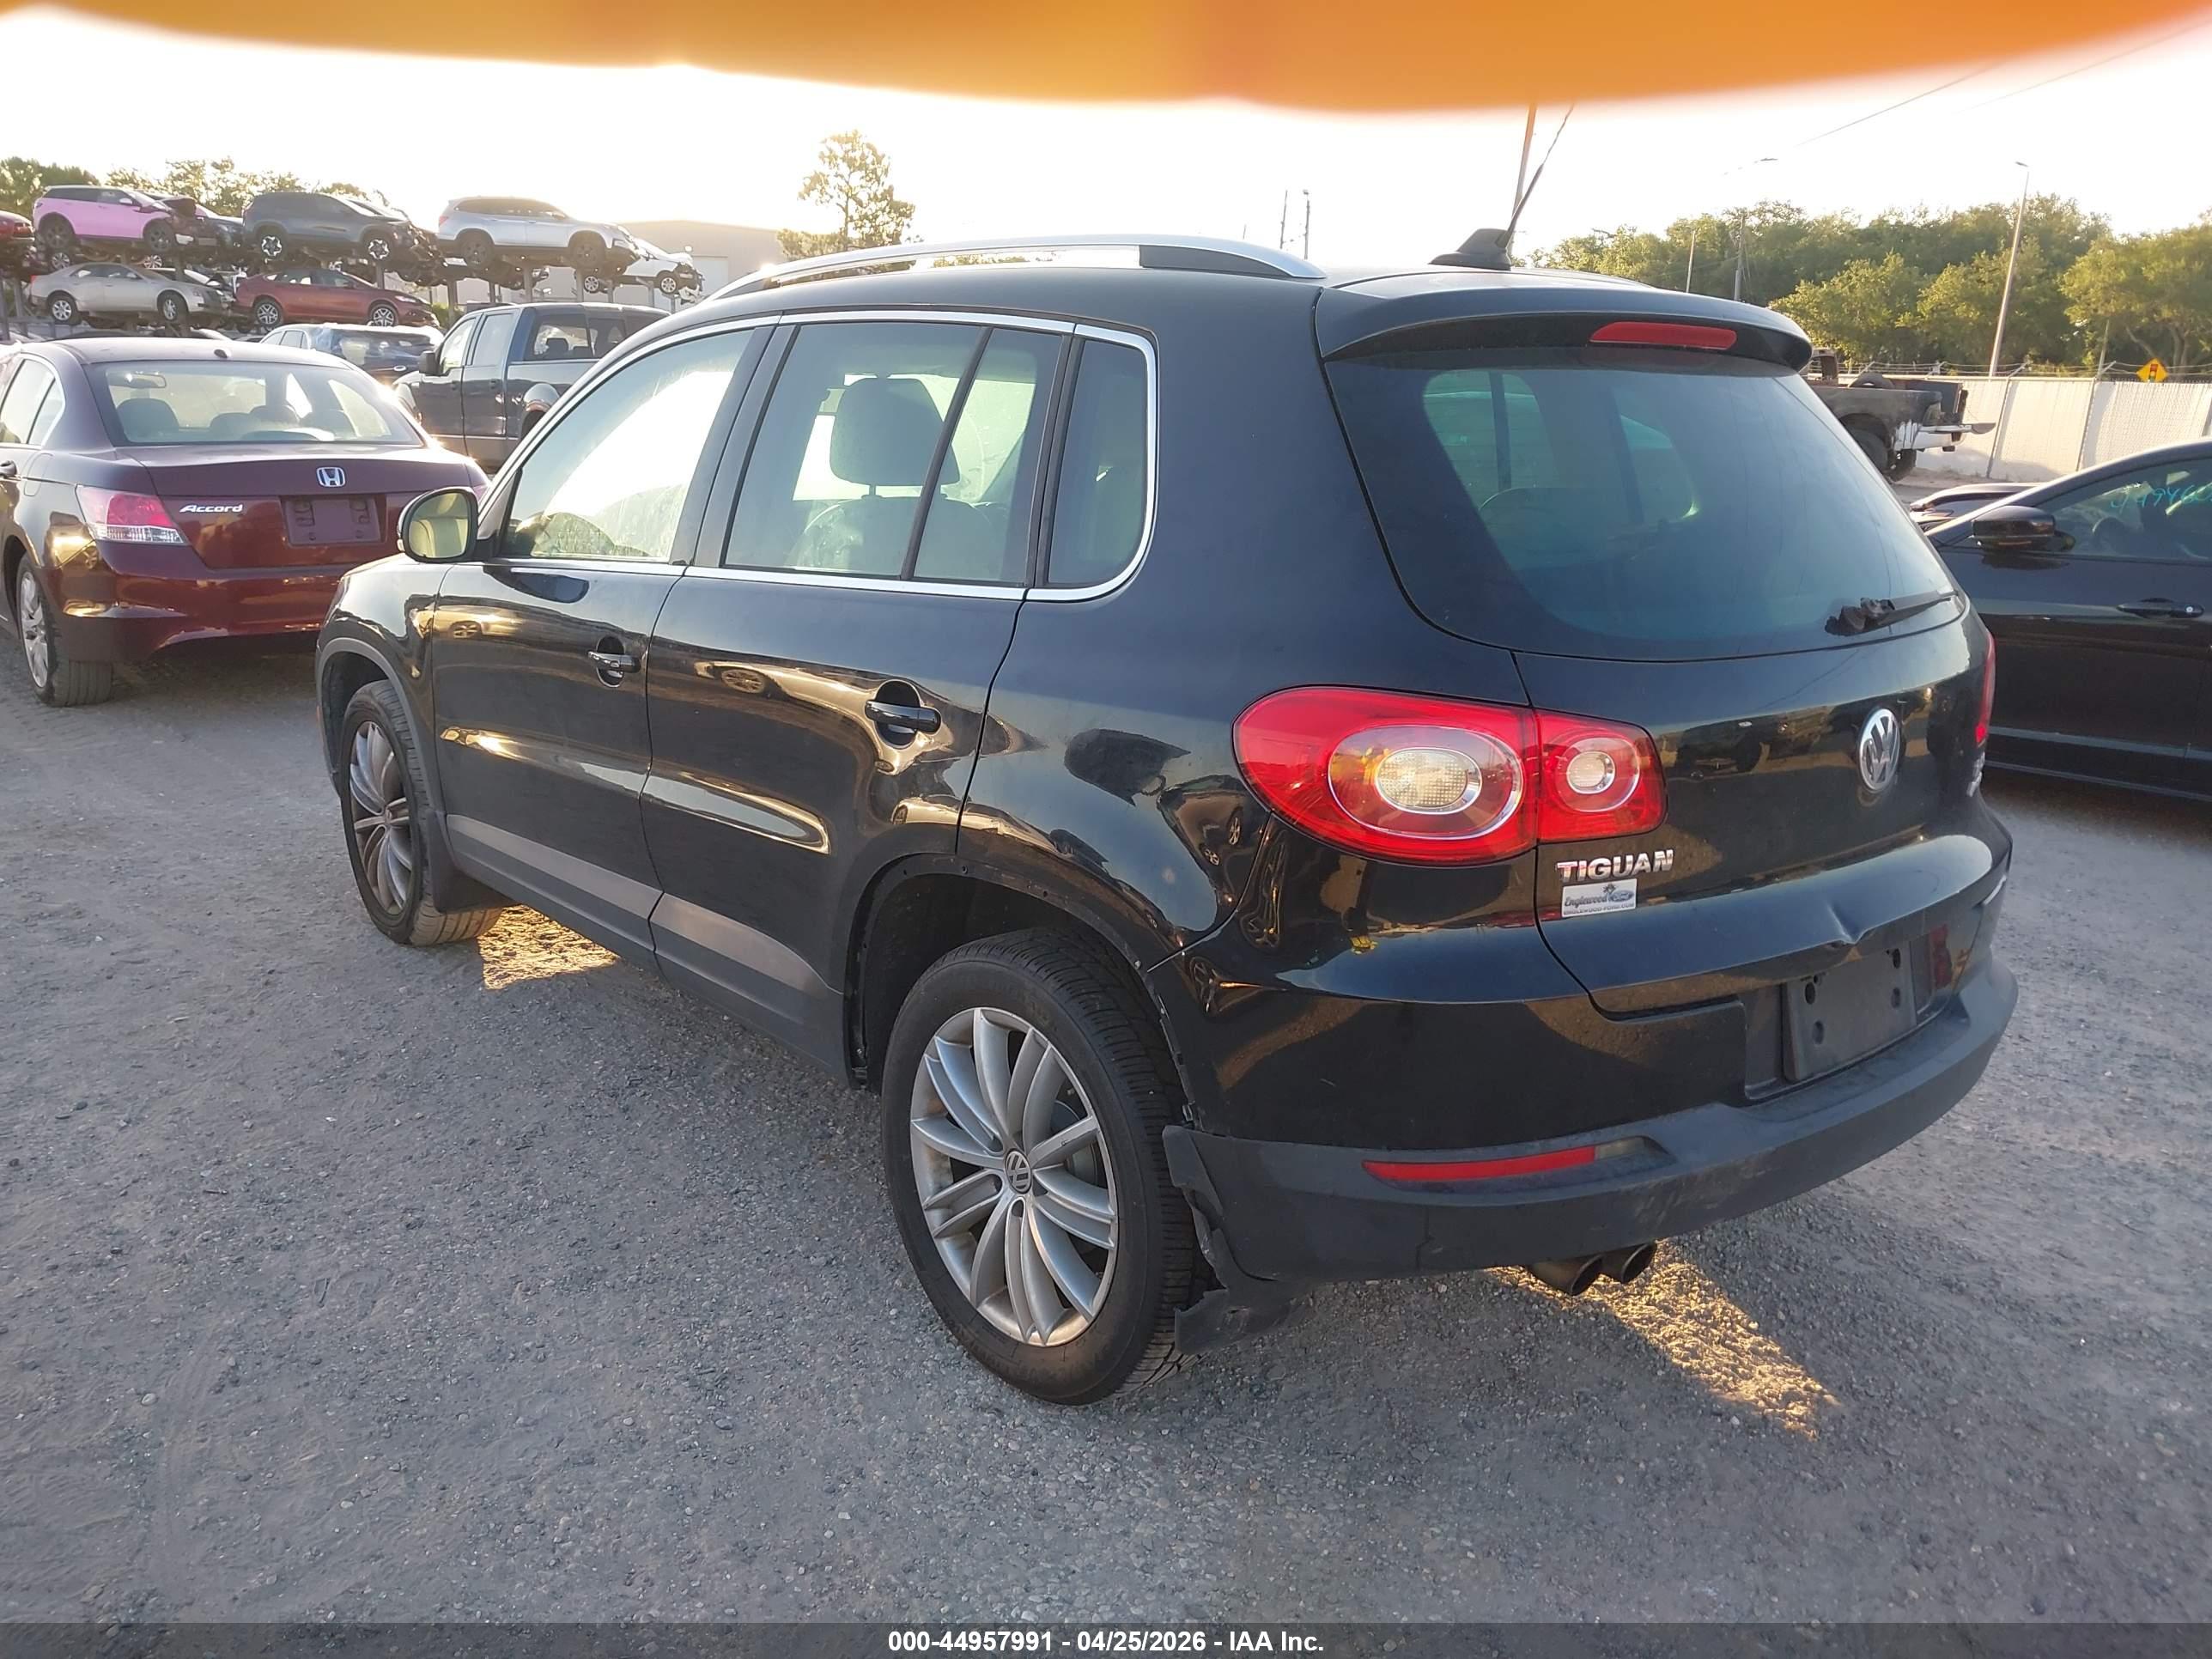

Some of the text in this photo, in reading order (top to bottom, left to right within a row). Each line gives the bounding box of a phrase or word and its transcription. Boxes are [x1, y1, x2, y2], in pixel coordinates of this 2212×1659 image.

[179, 503, 243, 513] Accord
[1859, 708, 1900, 790] VW
[1557, 848, 1674, 883] TIGUAN
